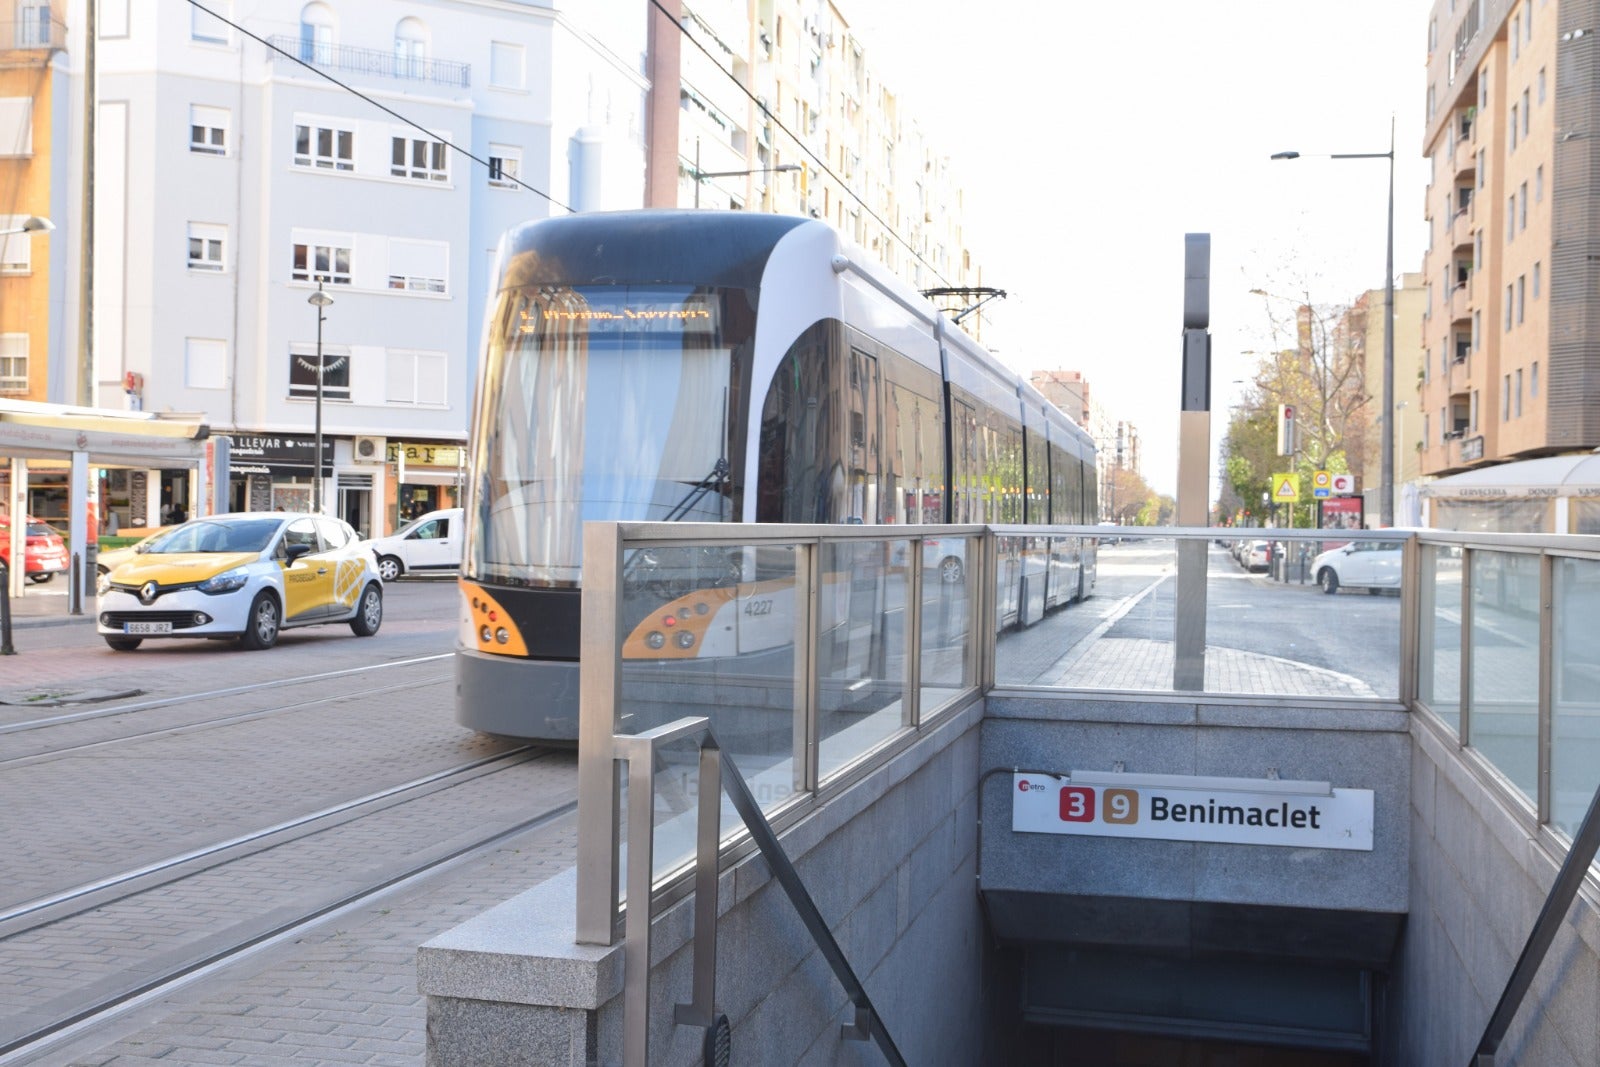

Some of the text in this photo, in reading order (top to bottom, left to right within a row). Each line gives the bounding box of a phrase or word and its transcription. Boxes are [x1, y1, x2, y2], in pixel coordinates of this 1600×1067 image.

[240, 438, 281, 449] LLEVAR
[1528, 488, 1559, 496] DONDE
[744, 600, 773, 617] 4227
[130, 623, 170, 633] 6658 JRZ
[1019, 780, 1046, 792] metro
[1068, 792, 1321, 829] 3 9 Benimaclet
